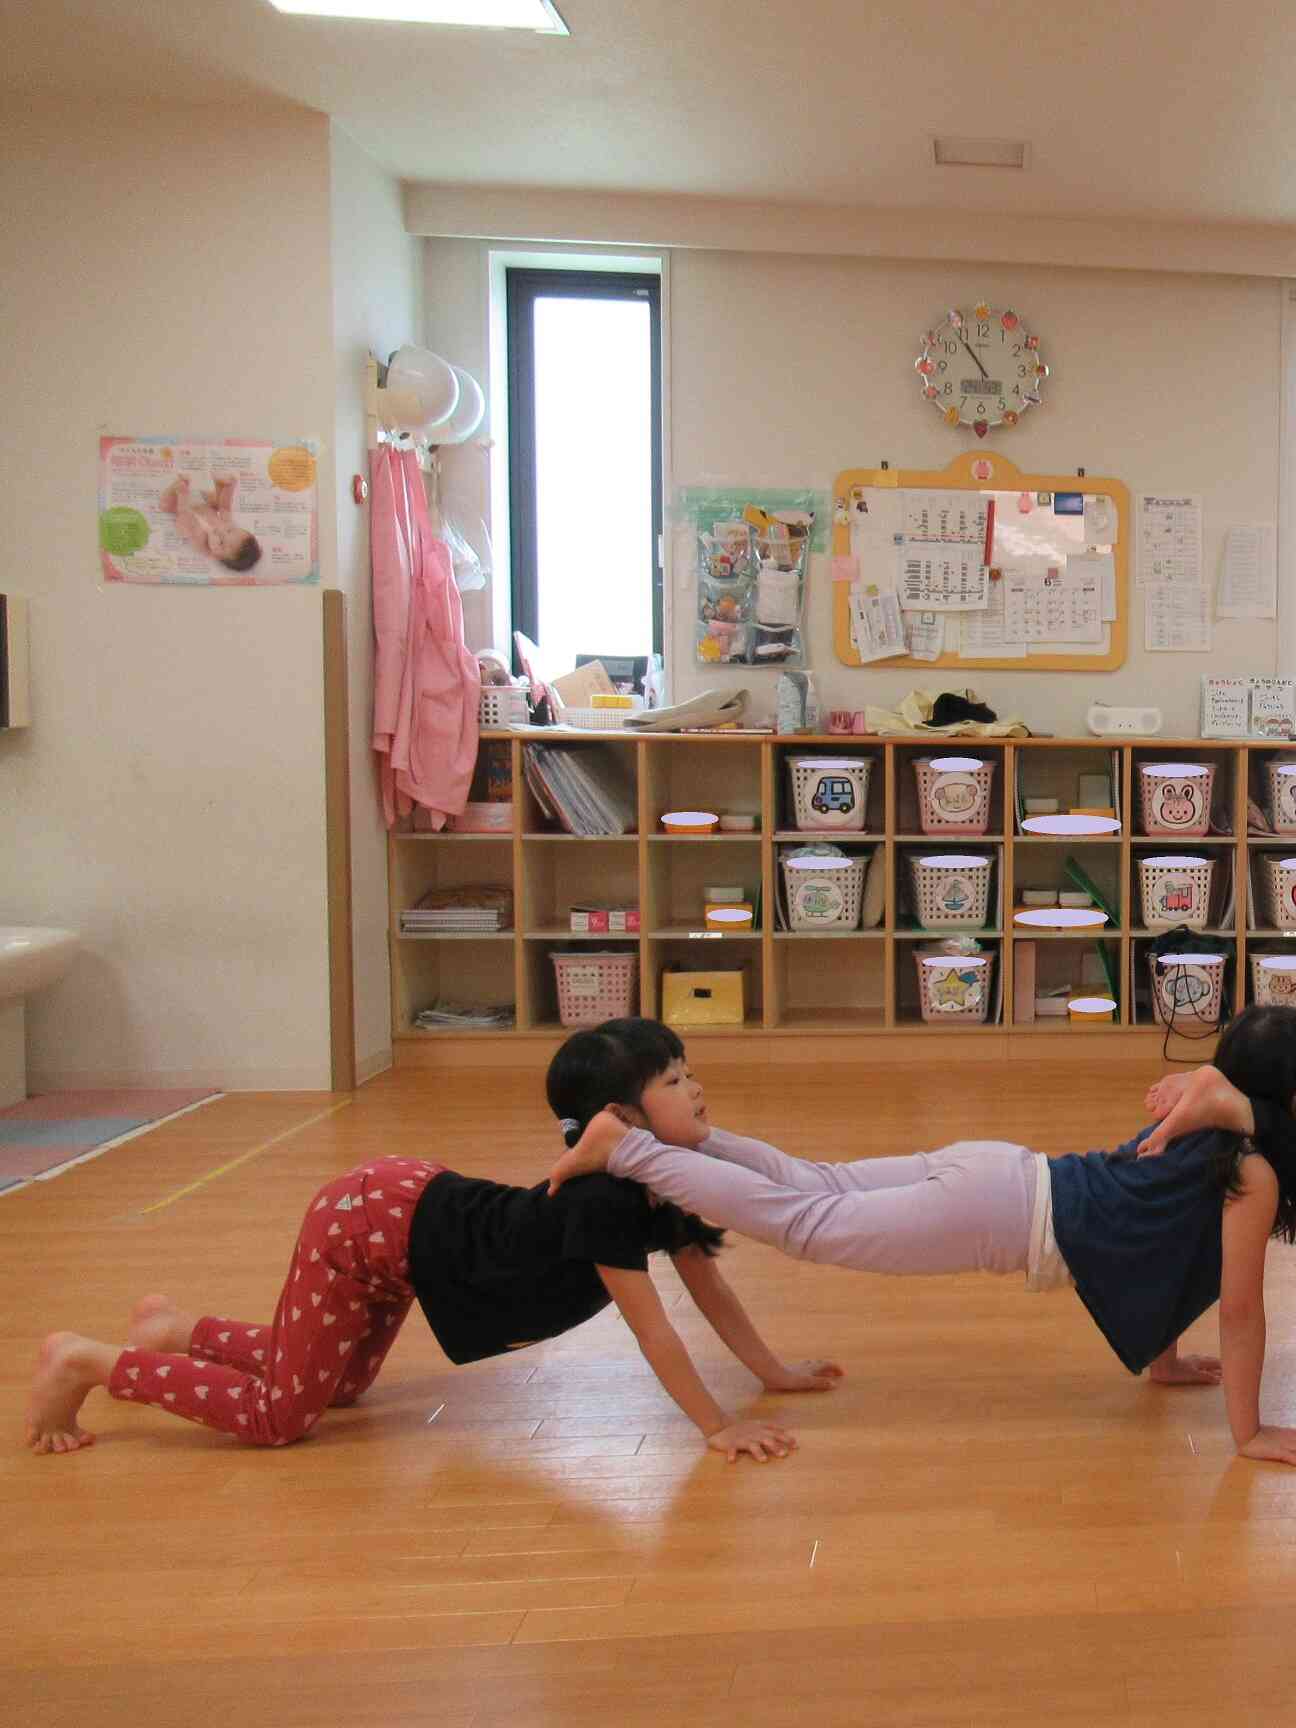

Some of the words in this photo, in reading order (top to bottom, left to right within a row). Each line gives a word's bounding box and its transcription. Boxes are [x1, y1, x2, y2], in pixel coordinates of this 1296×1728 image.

[976, 324, 990, 337] 12
[944, 341, 957, 353] 10
[1012, 344, 1021, 357] 2
[938, 361, 947, 375] 9
[1018, 365, 1026, 378] 3
[944, 383, 952, 395] 8
[1012, 384, 1020, 395] 4
[960, 395, 968, 408] 7
[977, 401, 985, 414] 6
[998, 398, 1006, 410] 5
